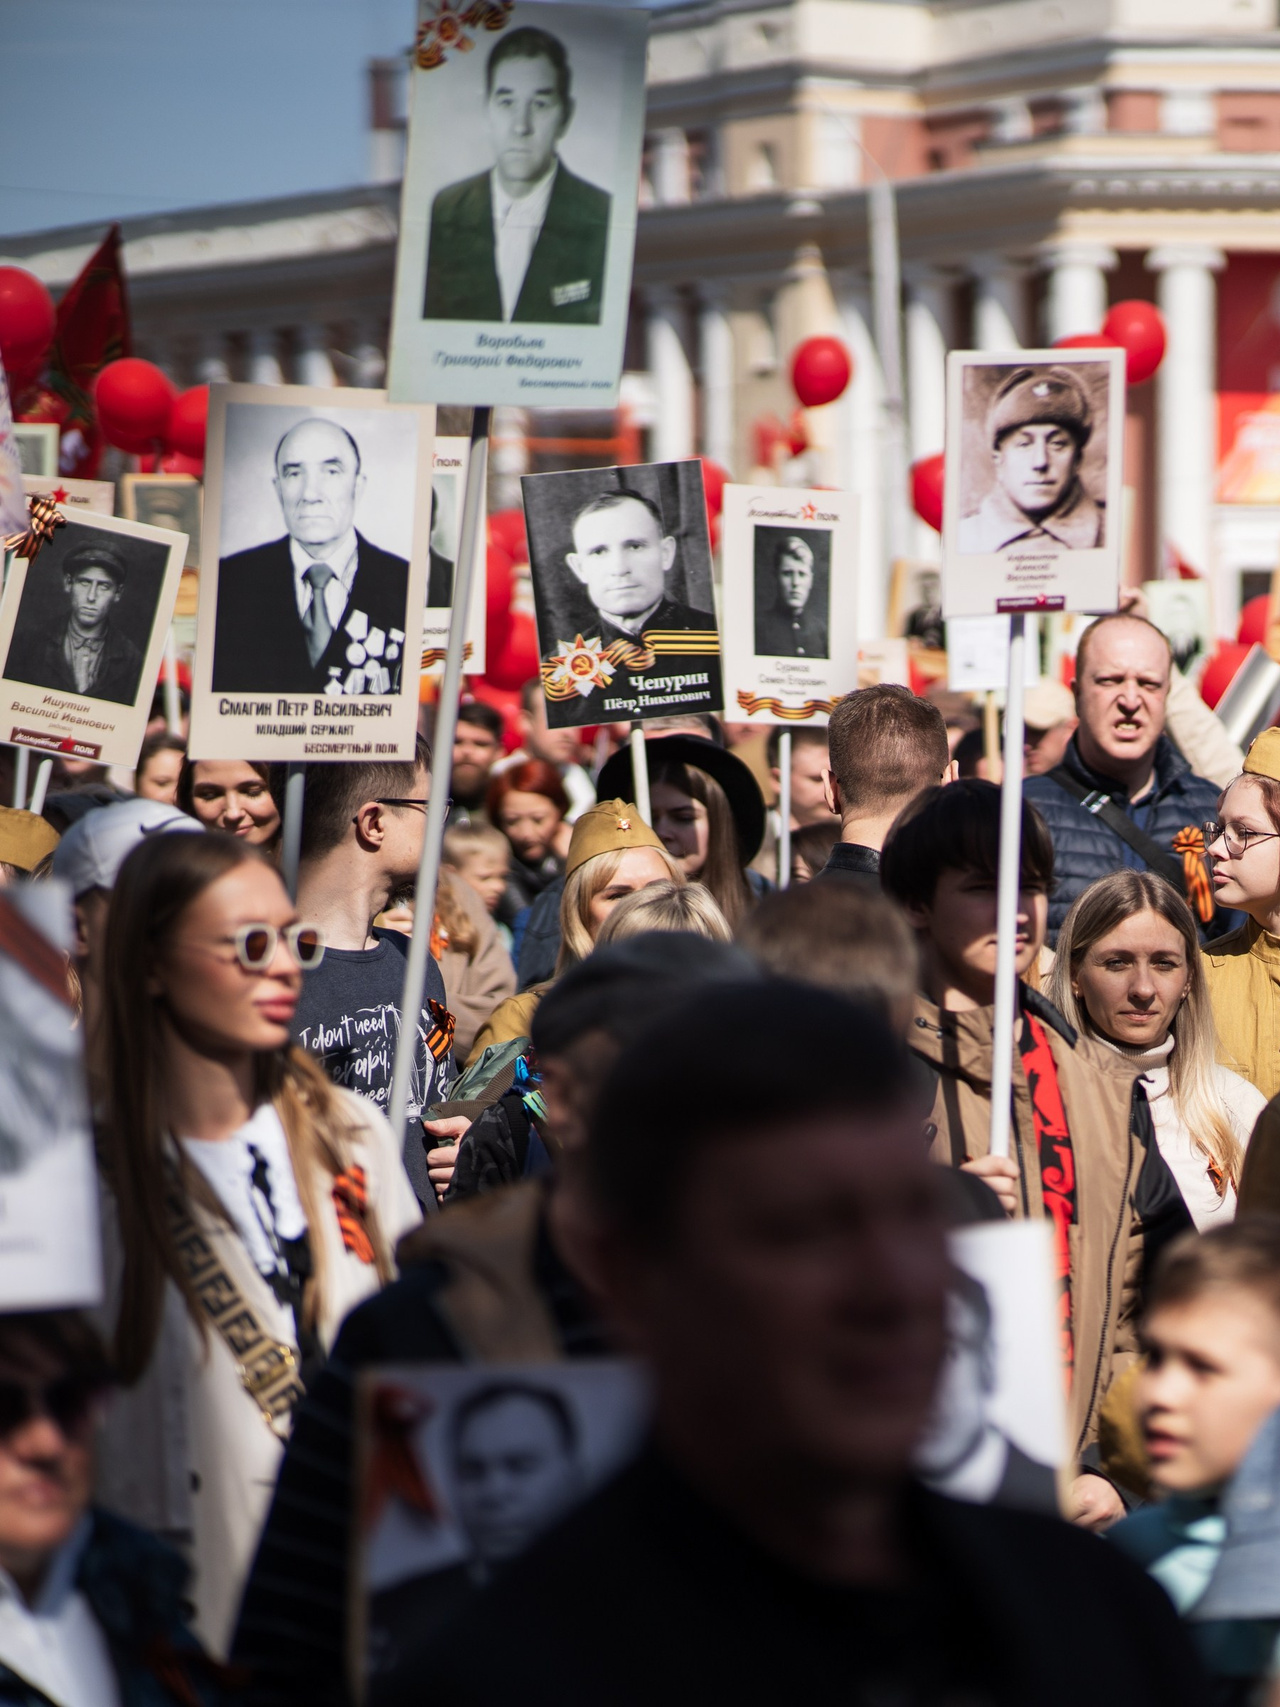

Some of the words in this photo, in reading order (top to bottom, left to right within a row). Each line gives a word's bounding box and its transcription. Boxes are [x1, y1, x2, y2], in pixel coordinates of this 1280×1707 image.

[628, 672, 710, 692] Чепурин
[43, 695, 92, 713] Ишутин
[637, 690, 711, 707] Никитович
[10, 701, 60, 720] Василий
[61, 712, 117, 732] Иванович
[256, 721, 307, 736] МЛАДШИЙ
[310, 723, 356, 736] СЕРЖАНТ
[304, 740, 373, 754] БЕССМЕРТНЫЙ
[374, 742, 400, 754] ПОЛК
[312, 1014, 353, 1055] don't
[354, 1007, 388, 1038] need
